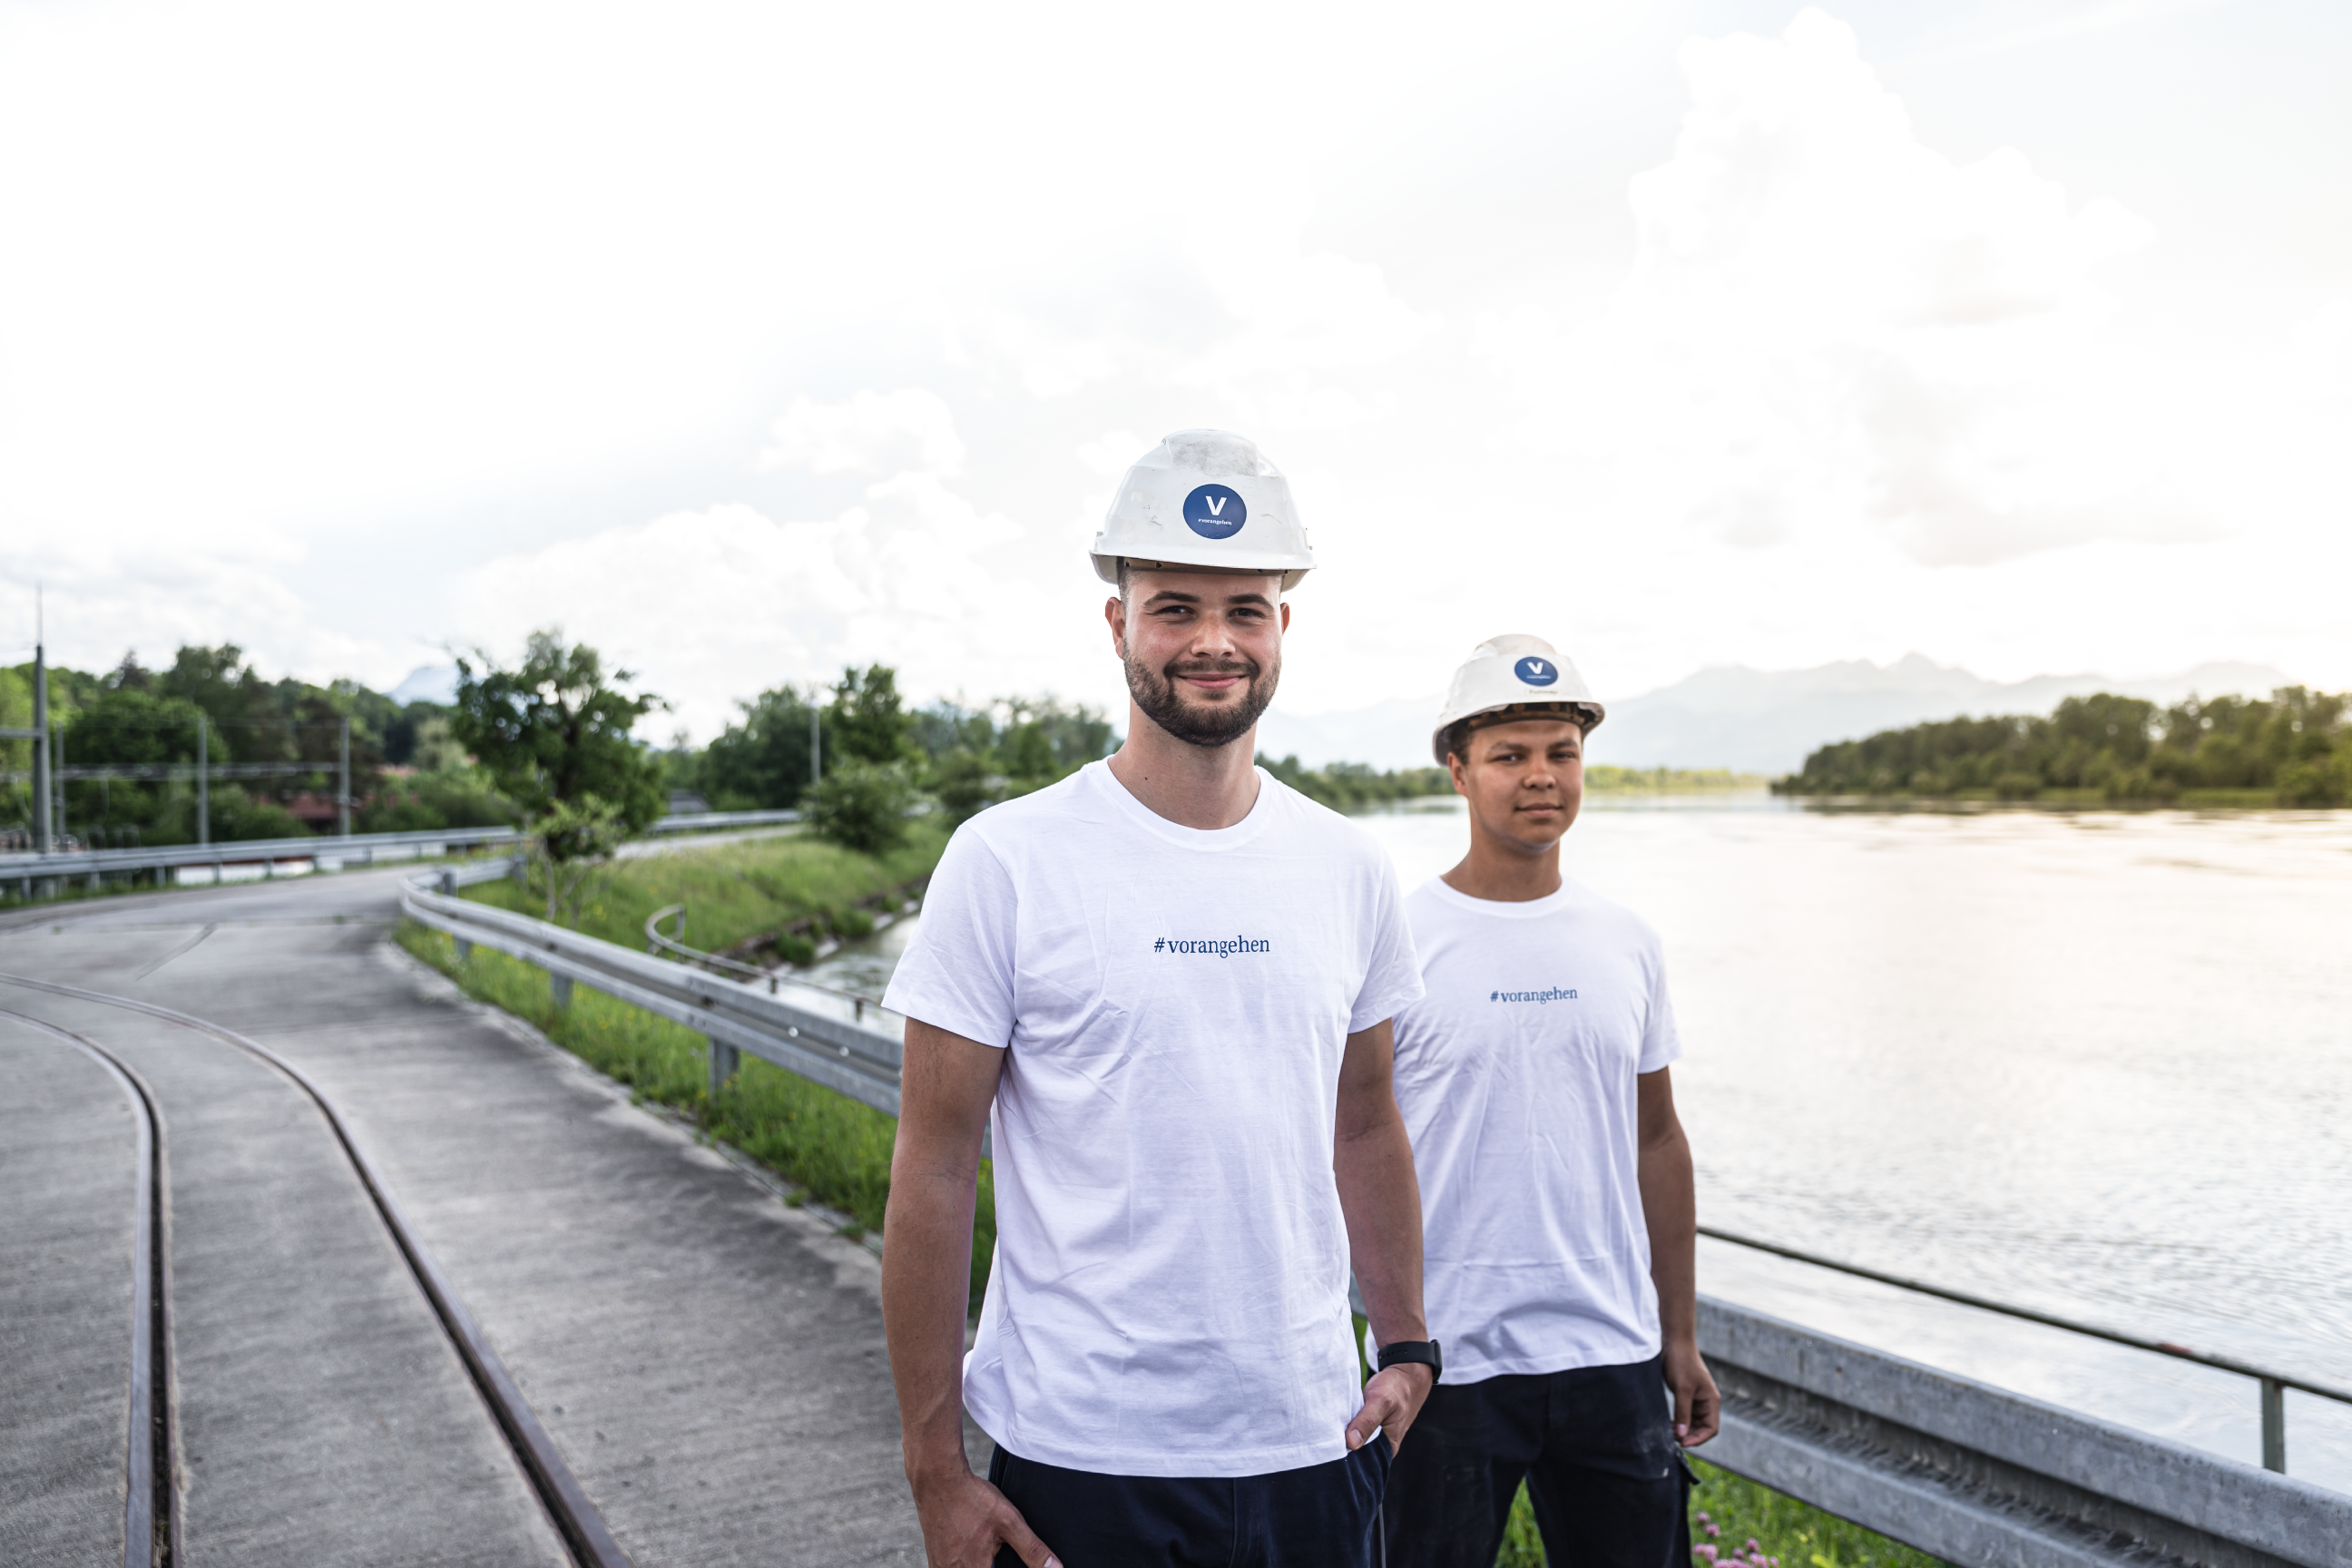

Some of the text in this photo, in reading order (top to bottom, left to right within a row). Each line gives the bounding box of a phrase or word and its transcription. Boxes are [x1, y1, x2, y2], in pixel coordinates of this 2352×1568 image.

[1205, 495, 1227, 516] V
[1526, 662, 1544, 674] V
[1153, 935, 1270, 959] #vorangehen
[1490, 985, 1578, 1005] #vorangehen
